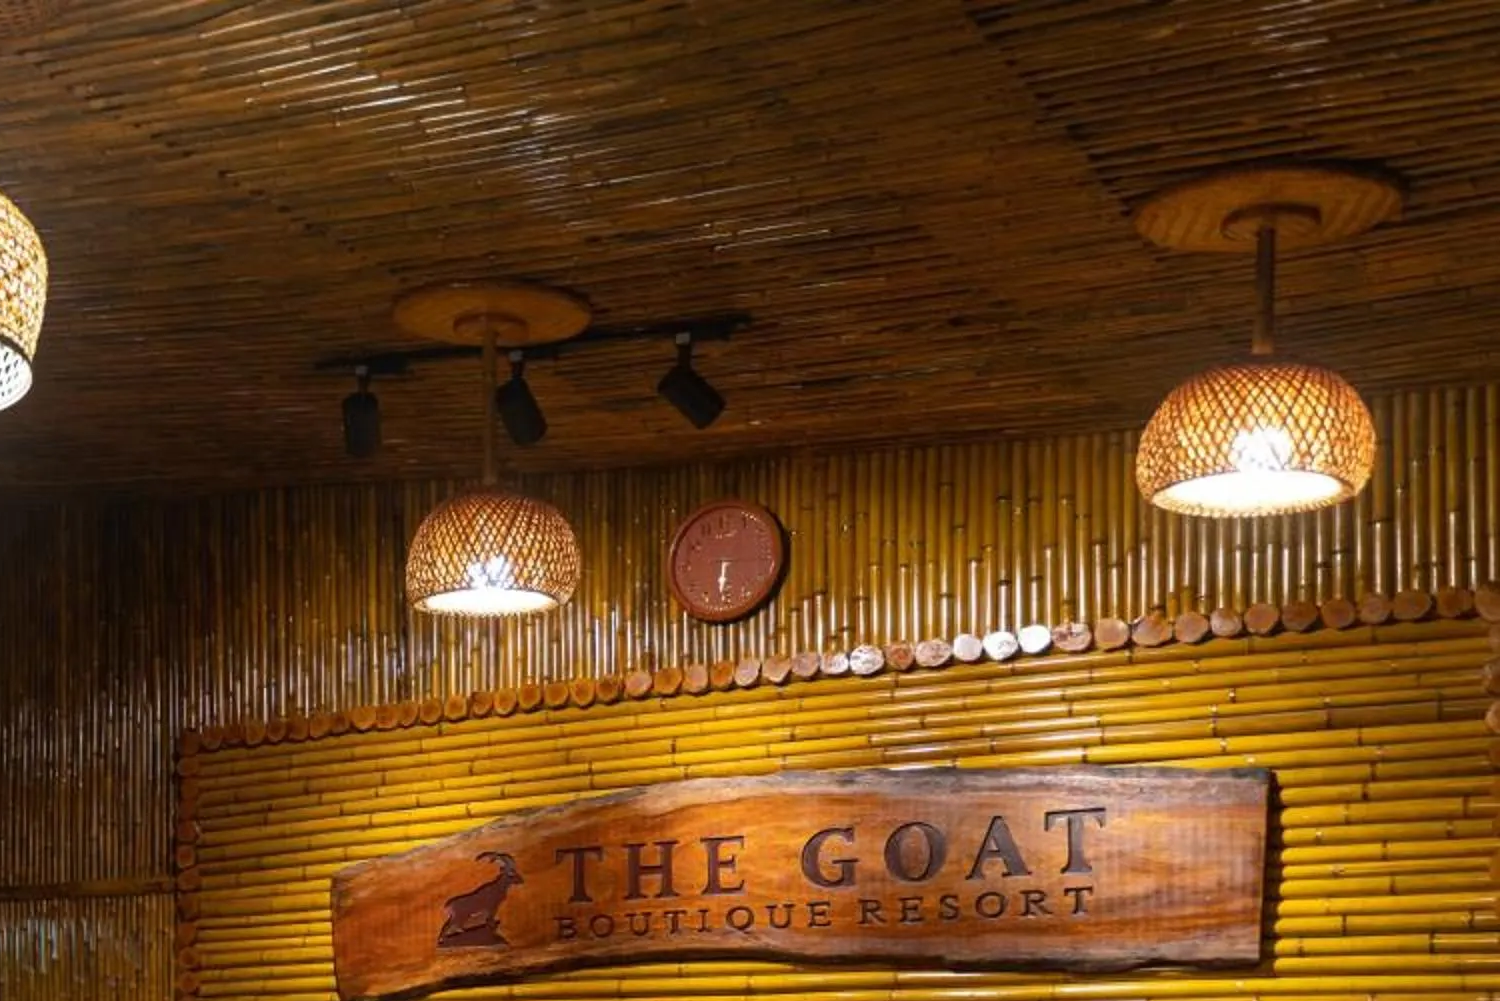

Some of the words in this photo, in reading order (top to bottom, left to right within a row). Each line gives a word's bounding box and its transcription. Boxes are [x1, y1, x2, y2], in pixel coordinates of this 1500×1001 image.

[555, 835, 746, 904] THE
[801, 807, 1107, 888] GOAT
[553, 901, 833, 940] BOUTIQUE
[856, 886, 1094, 925] RESORT
